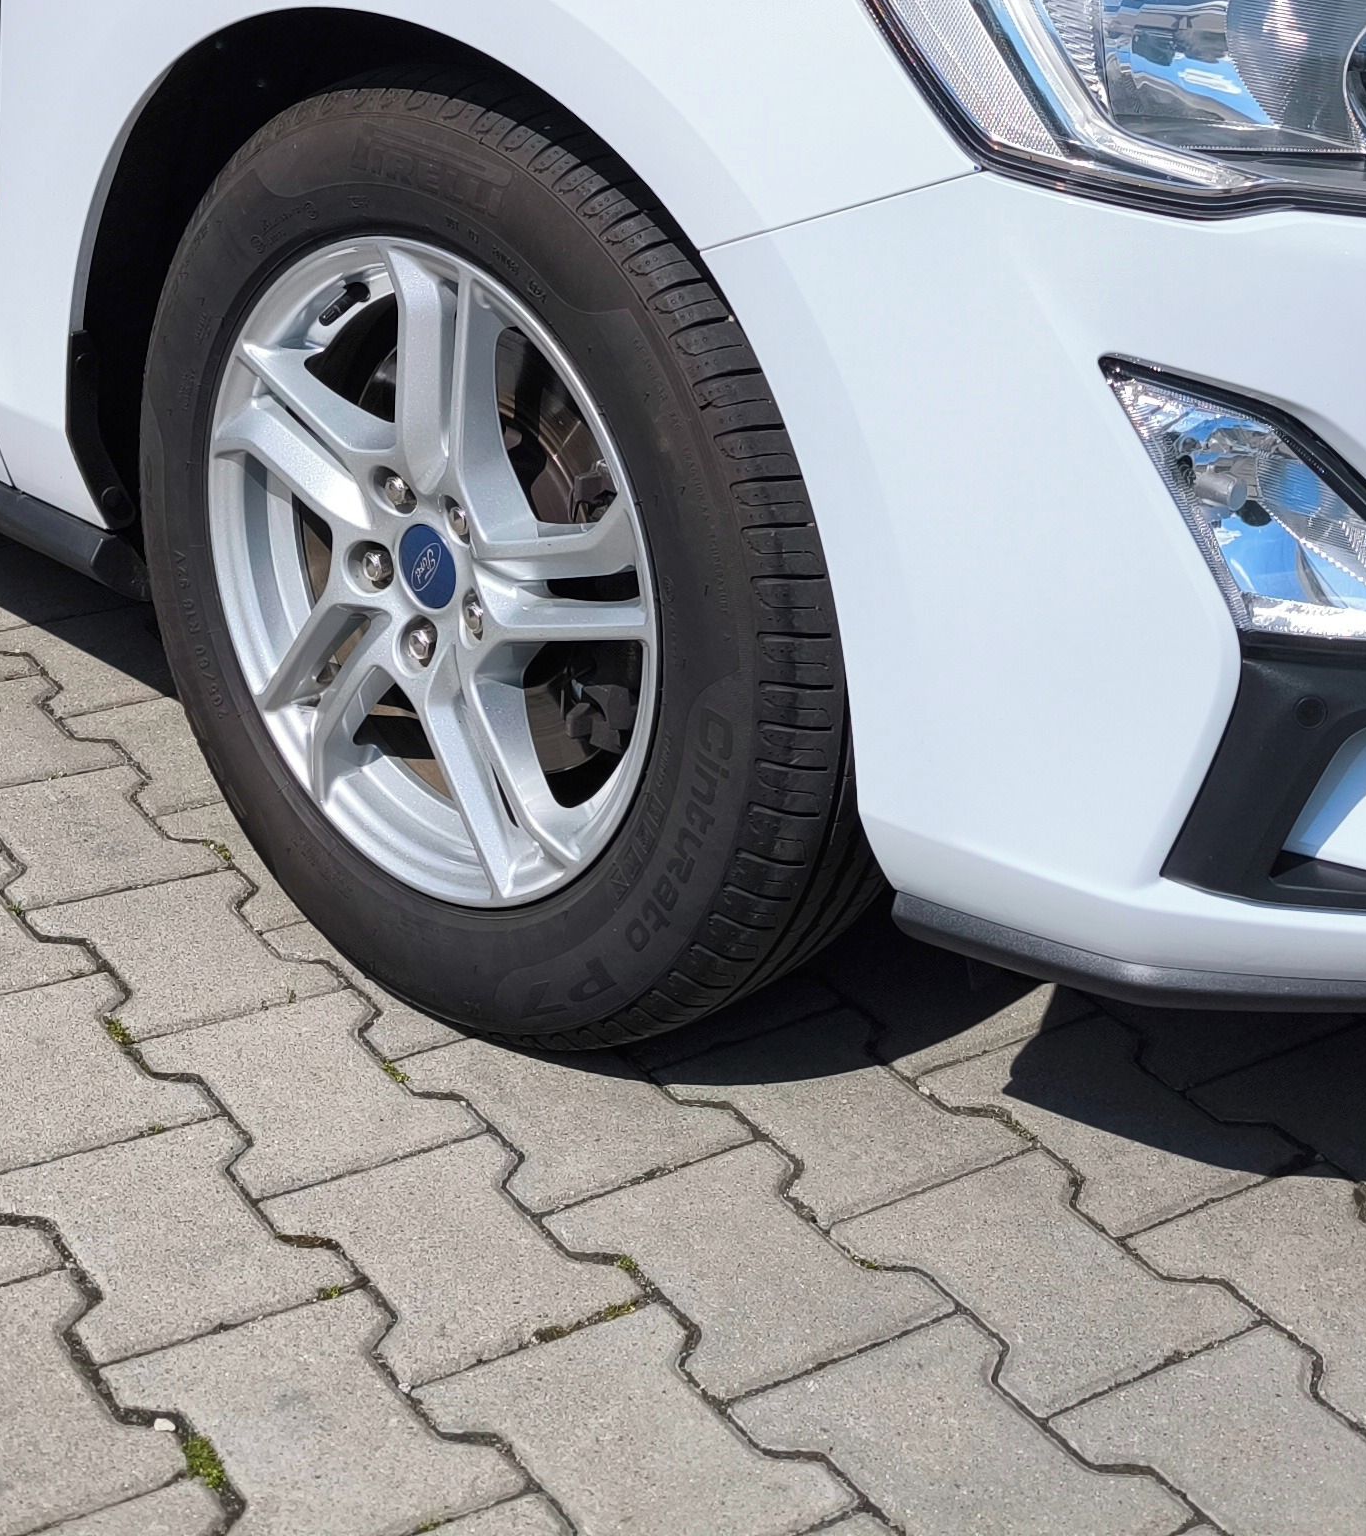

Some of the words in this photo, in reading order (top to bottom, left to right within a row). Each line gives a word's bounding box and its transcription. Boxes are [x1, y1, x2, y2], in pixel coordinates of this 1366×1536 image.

[349, 118, 512, 219] PIRELLI
[415, 547, 436, 585] Ford
[624, 705, 733, 953] Cinturato
[520, 955, 619, 1019] P7
